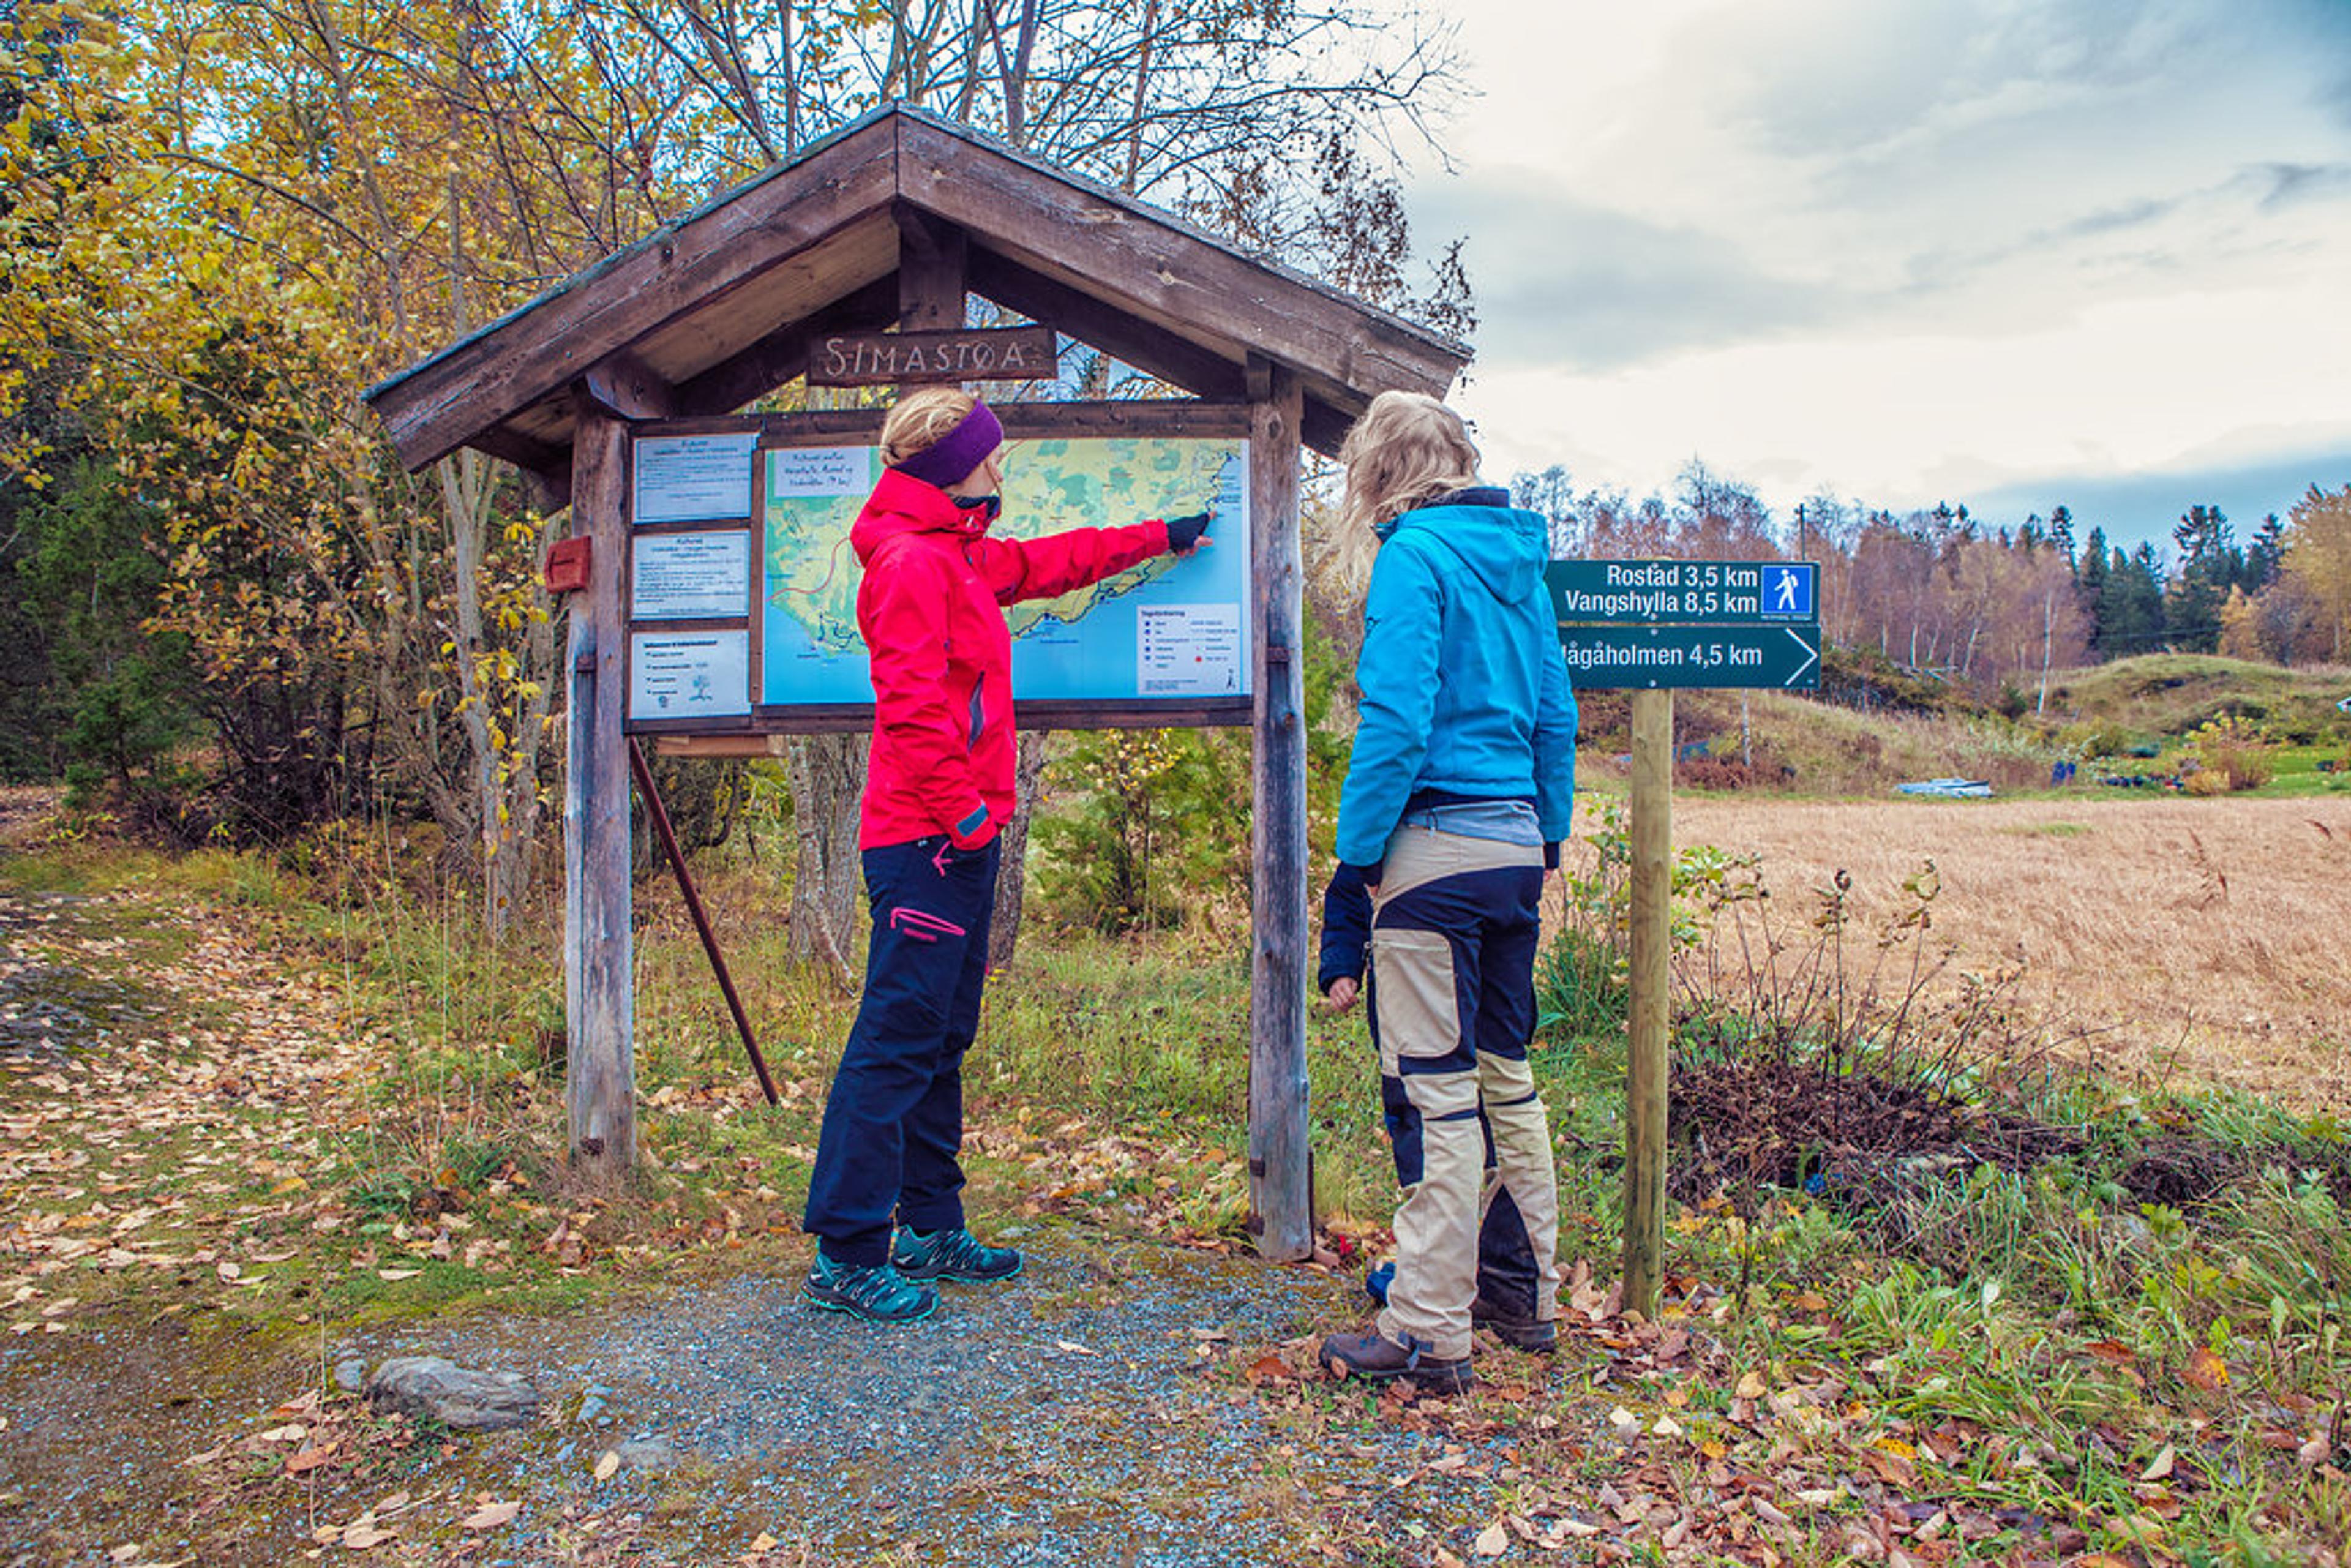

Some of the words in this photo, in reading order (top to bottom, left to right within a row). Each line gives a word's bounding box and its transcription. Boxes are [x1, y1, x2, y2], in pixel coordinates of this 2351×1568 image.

[825, 337, 1025, 377] SIMASTØA
[1607, 565, 1679, 586] Rostad
[1685, 566, 1718, 590] 3,5
[1725, 566, 1757, 586] km
[1565, 590, 1678, 616] Vangshylla
[1684, 592, 1718, 615] 8,5
[1724, 592, 1757, 612] km
[1689, 645, 1722, 669] 4,5
[1729, 644, 1762, 664] km
